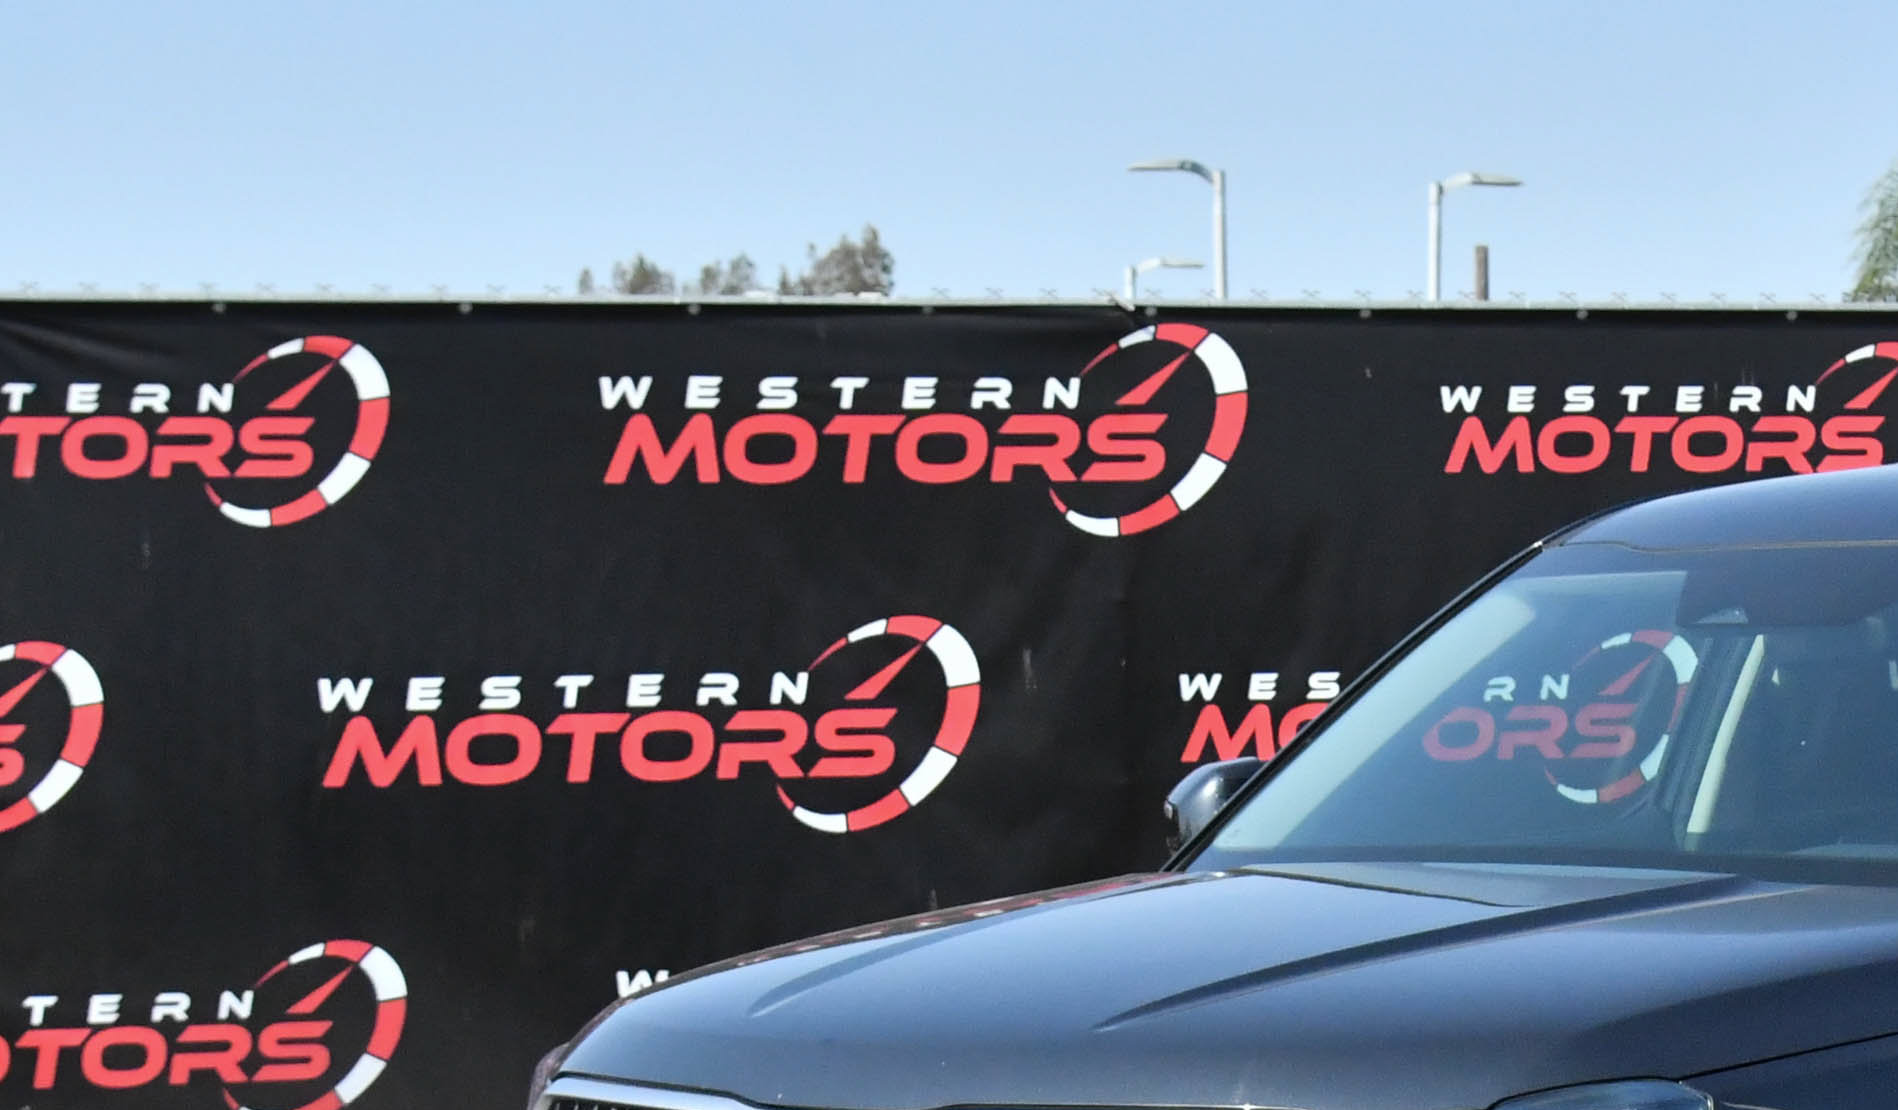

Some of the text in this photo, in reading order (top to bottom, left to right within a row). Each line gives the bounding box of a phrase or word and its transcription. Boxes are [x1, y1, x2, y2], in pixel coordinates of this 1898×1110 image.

[600, 376, 1080, 410] WESTERN
[1440, 385, 1817, 413] WESTERN
[604, 413, 1168, 485] MOTORS
[1444, 416, 1886, 474] MOTORS
[317, 672, 809, 712] WESTERN
[322, 708, 898, 788] MOTORS
